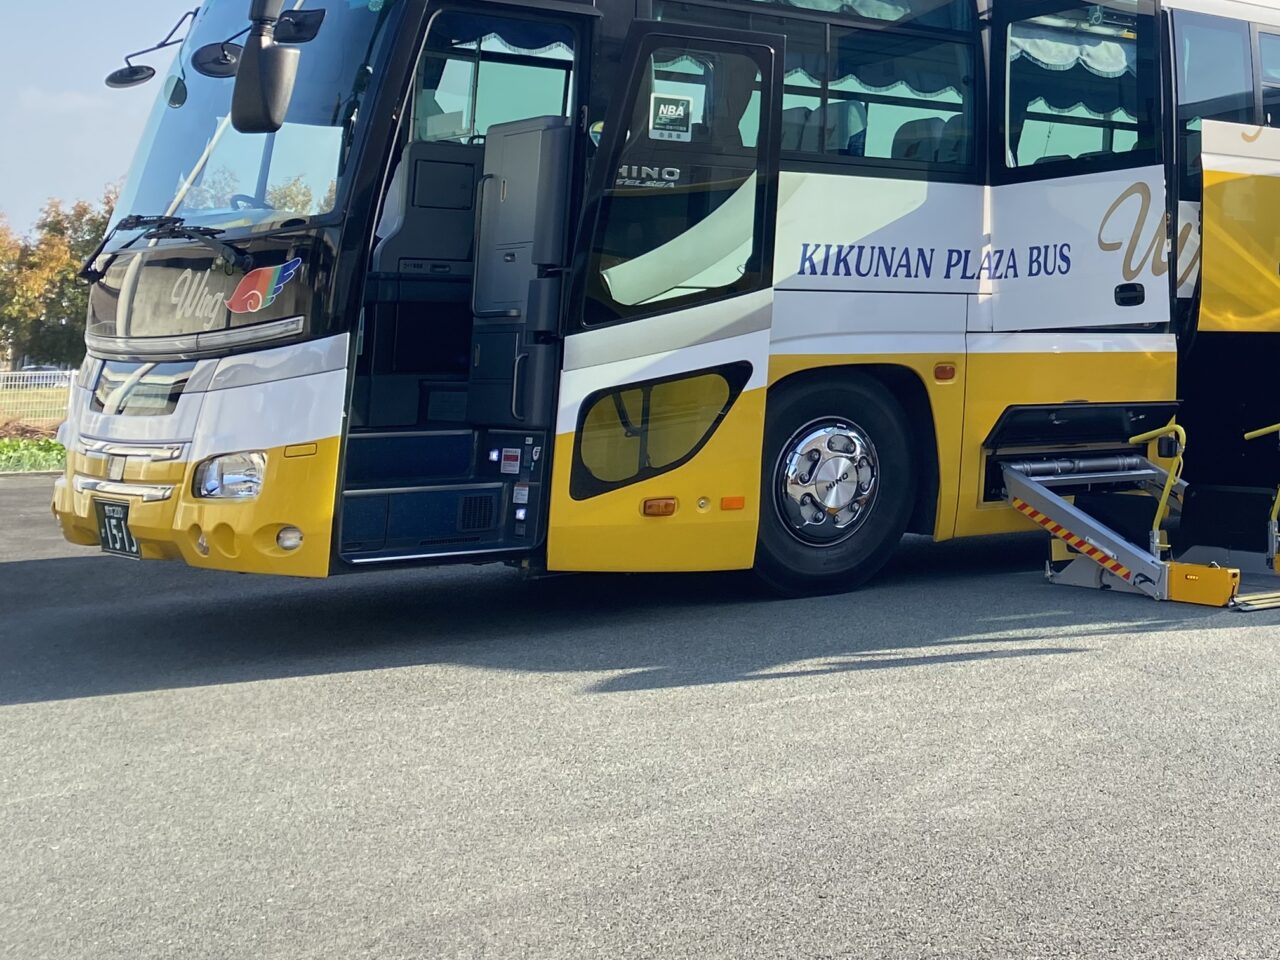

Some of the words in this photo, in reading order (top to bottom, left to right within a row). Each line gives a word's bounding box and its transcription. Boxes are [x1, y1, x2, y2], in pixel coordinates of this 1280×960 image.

[659, 104, 684, 117] NBA
[798, 243, 935, 278] KIKUNAN
[944, 249, 1018, 280] PLAZA
[1028, 243, 1071, 277] BUS
[171, 268, 224, 331] Wing
[826, 472, 849, 491] HINO
